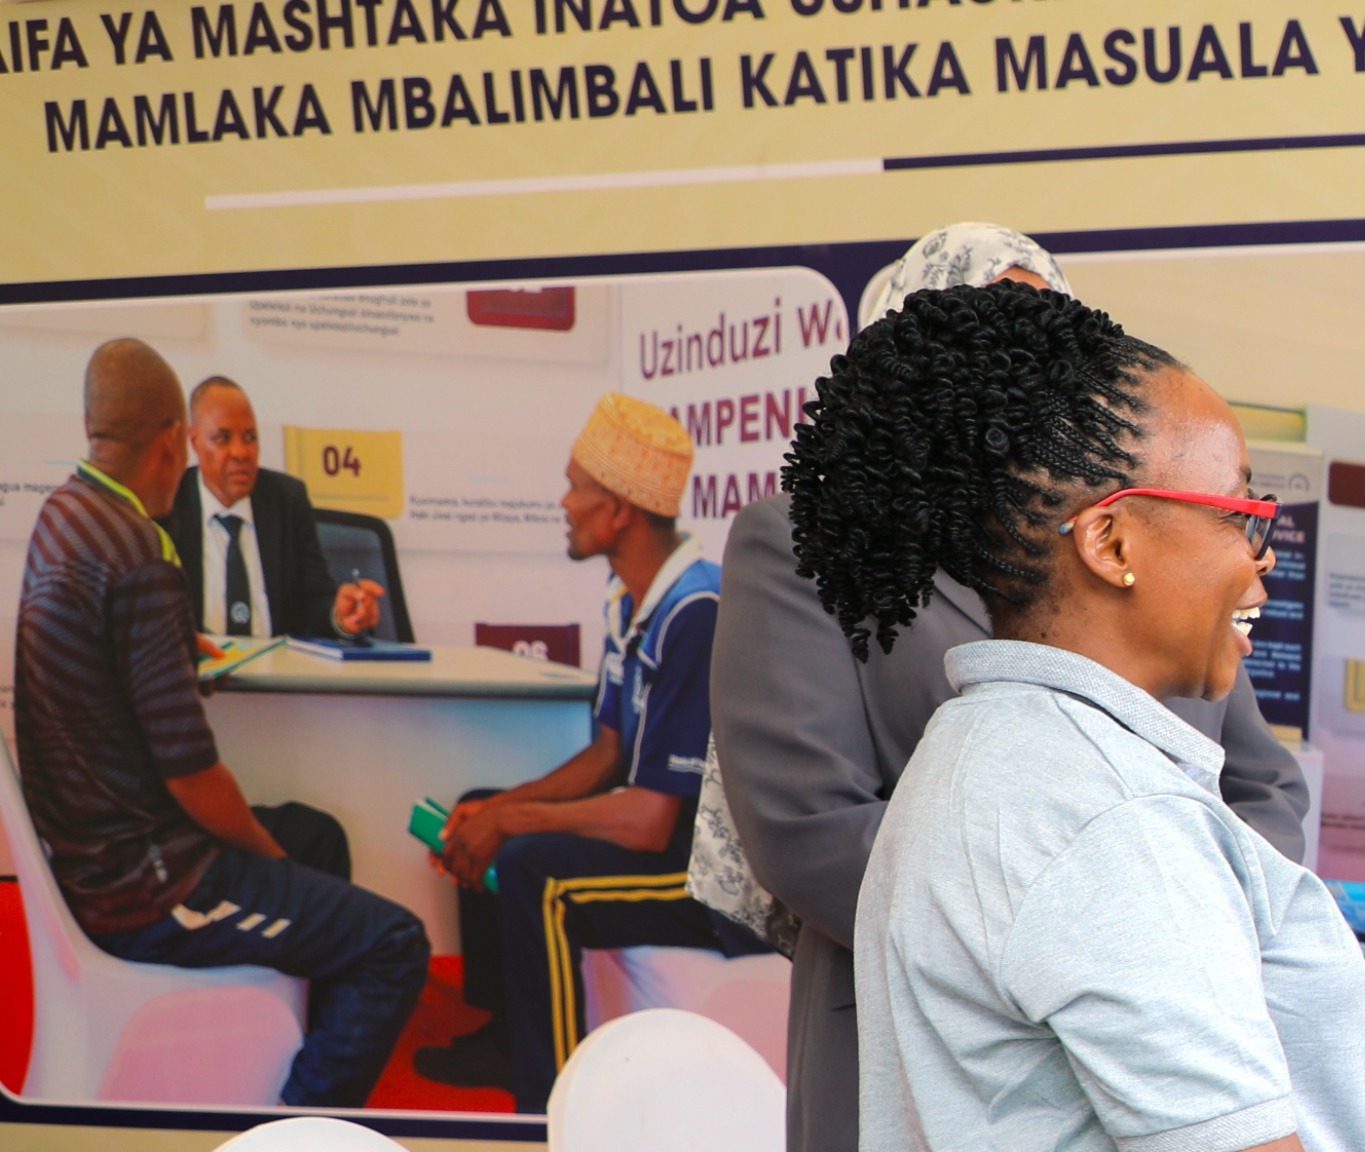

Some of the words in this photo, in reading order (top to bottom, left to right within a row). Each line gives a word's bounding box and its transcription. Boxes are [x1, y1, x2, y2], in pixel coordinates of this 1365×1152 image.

[101, 10, 174, 65] YA
[191, 0, 513, 59] MASHTAKA
[44, 83, 333, 153] MAMLAKA
[350, 56, 715, 134] MBALIMBALI
[739, 40, 973, 109] KATIKA
[994, 19, 1320, 92] MASUALA
[640, 297, 782, 380] Uzinduzi
[798, 299, 842, 349] W
[322, 444, 361, 478] 04
